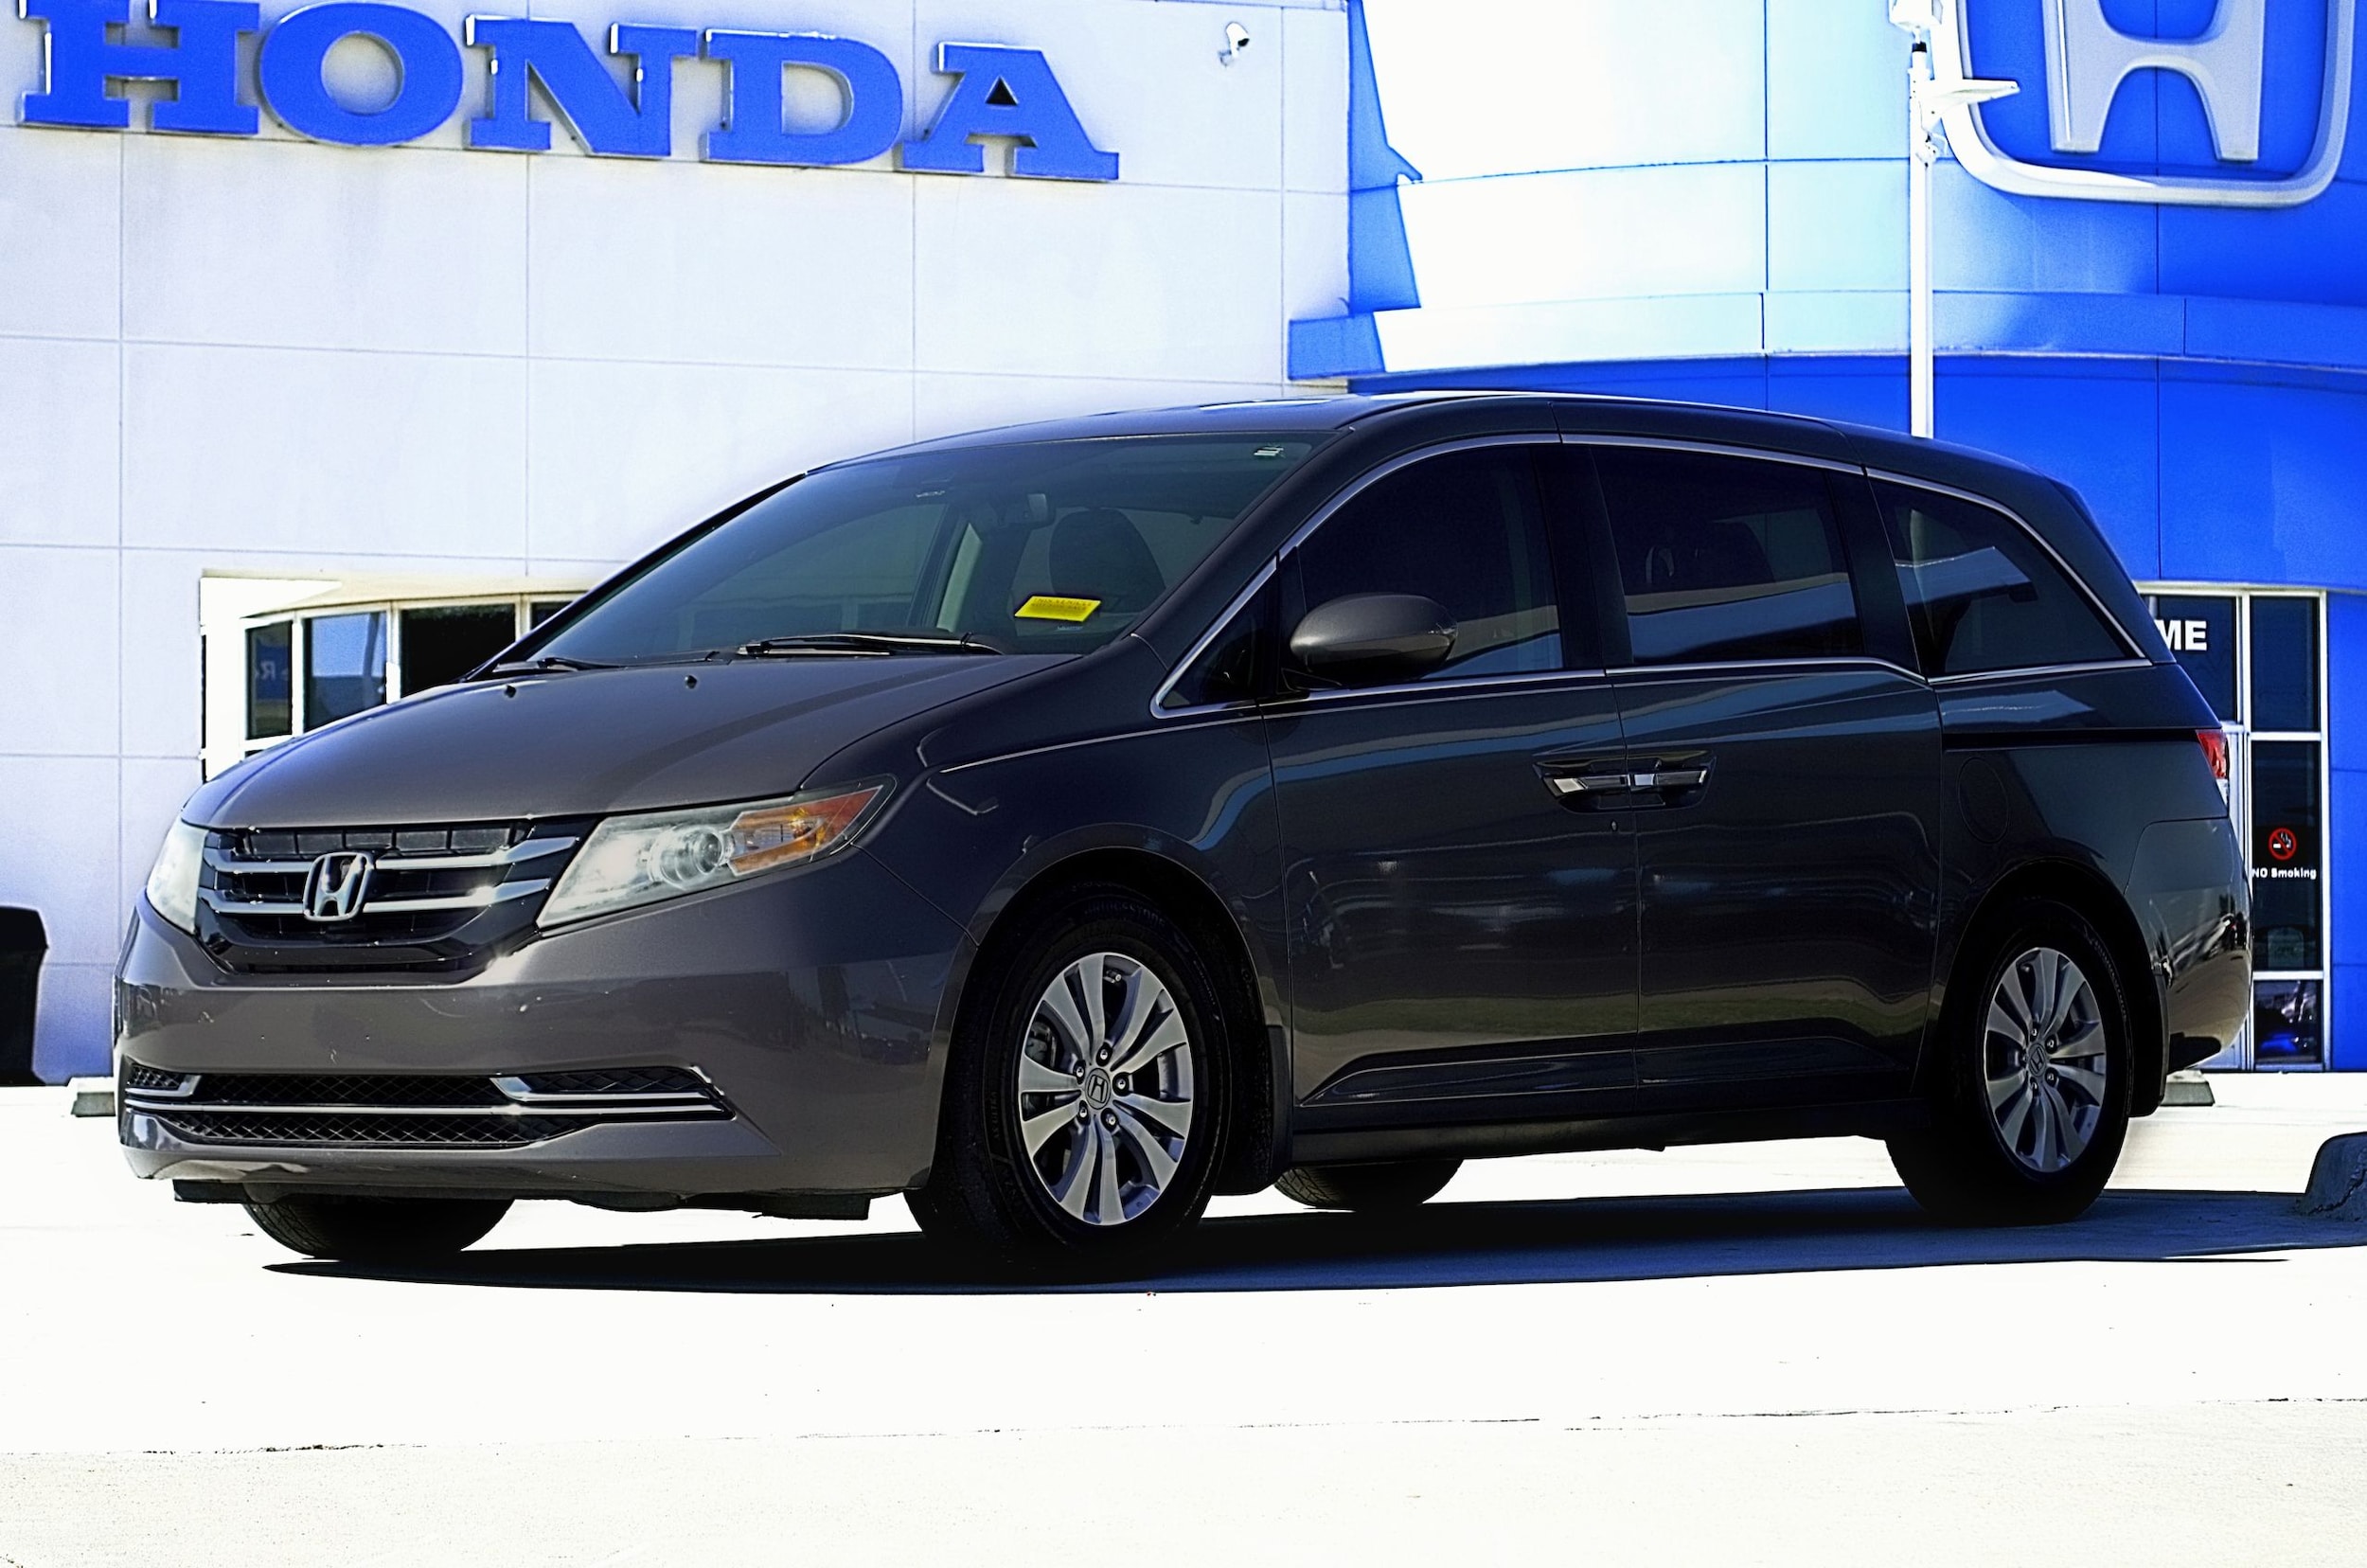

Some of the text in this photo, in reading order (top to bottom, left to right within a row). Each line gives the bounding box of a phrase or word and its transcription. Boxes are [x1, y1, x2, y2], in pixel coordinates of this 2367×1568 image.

[17, 0, 1121, 180] HONDA
[2251, 866, 2317, 880] NO Smoking
